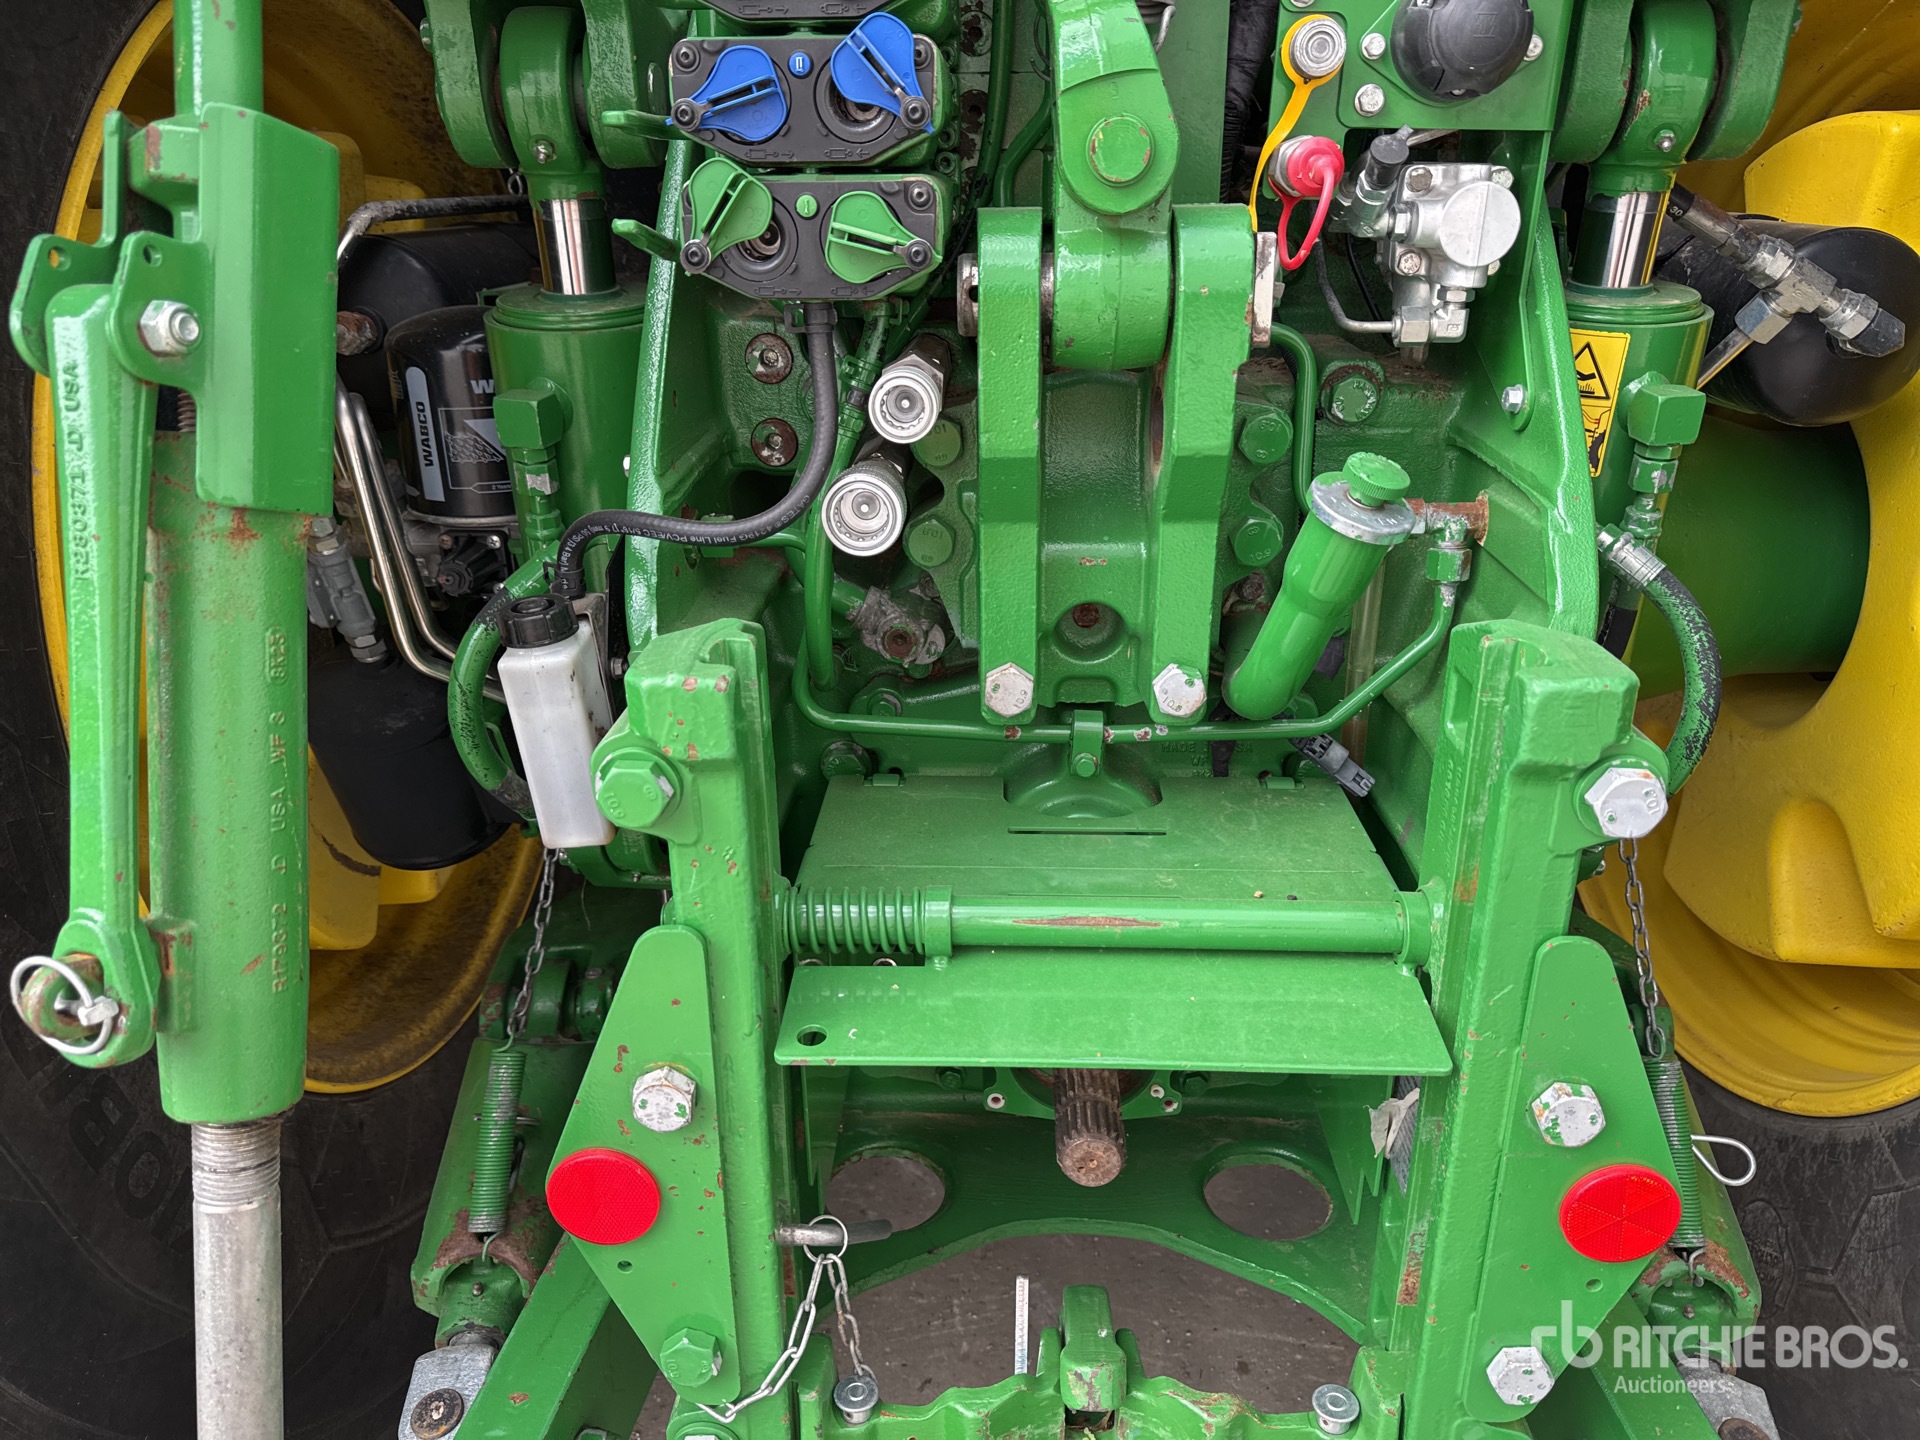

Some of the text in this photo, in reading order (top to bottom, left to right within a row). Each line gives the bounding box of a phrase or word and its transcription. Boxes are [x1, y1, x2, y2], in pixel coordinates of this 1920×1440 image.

[470, 379, 495, 394] W
[415, 401, 435, 468] WABCO
[690, 535, 712, 544] Line
[713, 535, 738, 544] Fuel
[270, 786, 286, 831] USA
